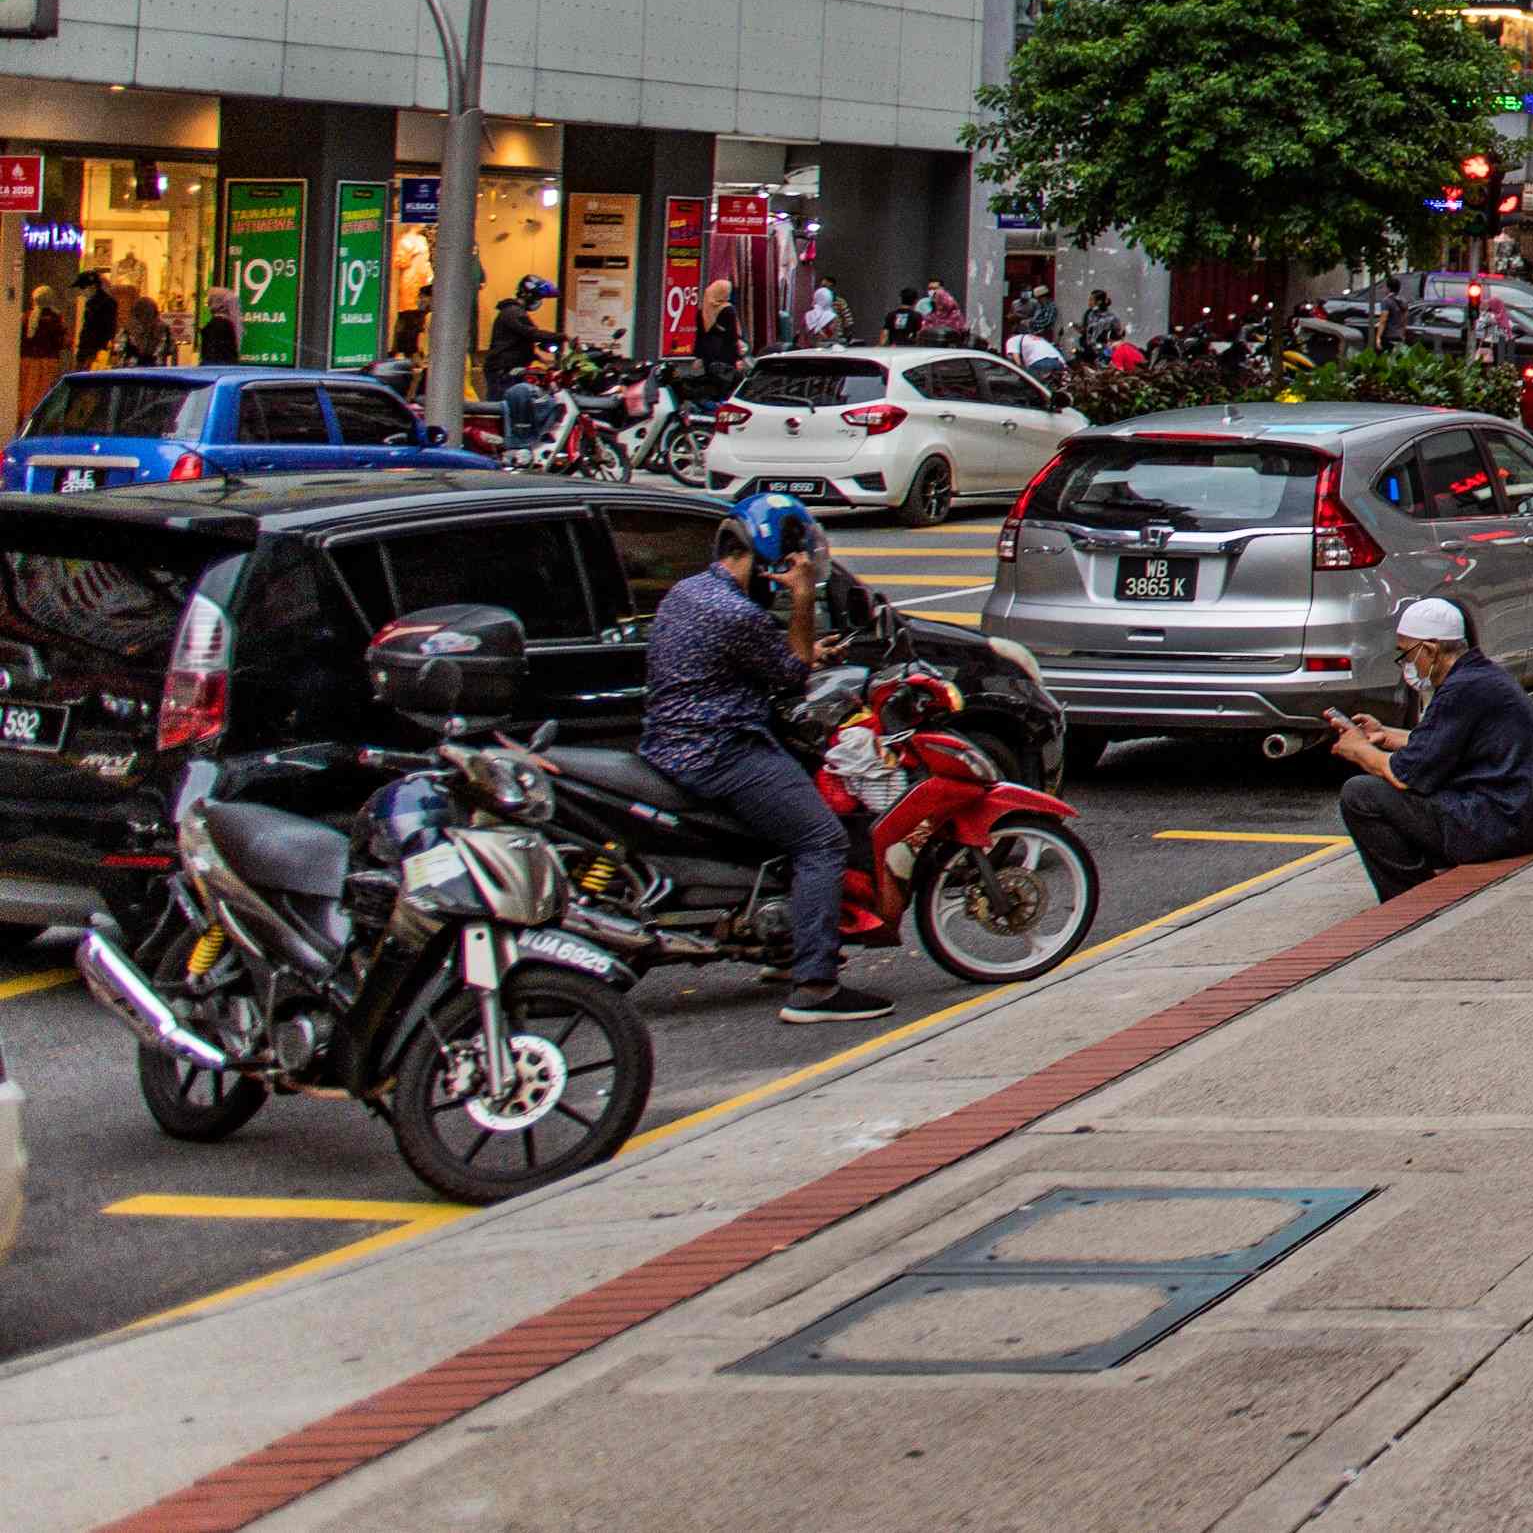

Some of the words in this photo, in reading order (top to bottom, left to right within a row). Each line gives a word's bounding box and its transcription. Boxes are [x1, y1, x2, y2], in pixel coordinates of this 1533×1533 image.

[667, 286, 685, 333] 9
[1145, 559, 1169, 578] WB
[1125, 577, 1170, 597] 3865
[1173, 577, 1187, 597] K
